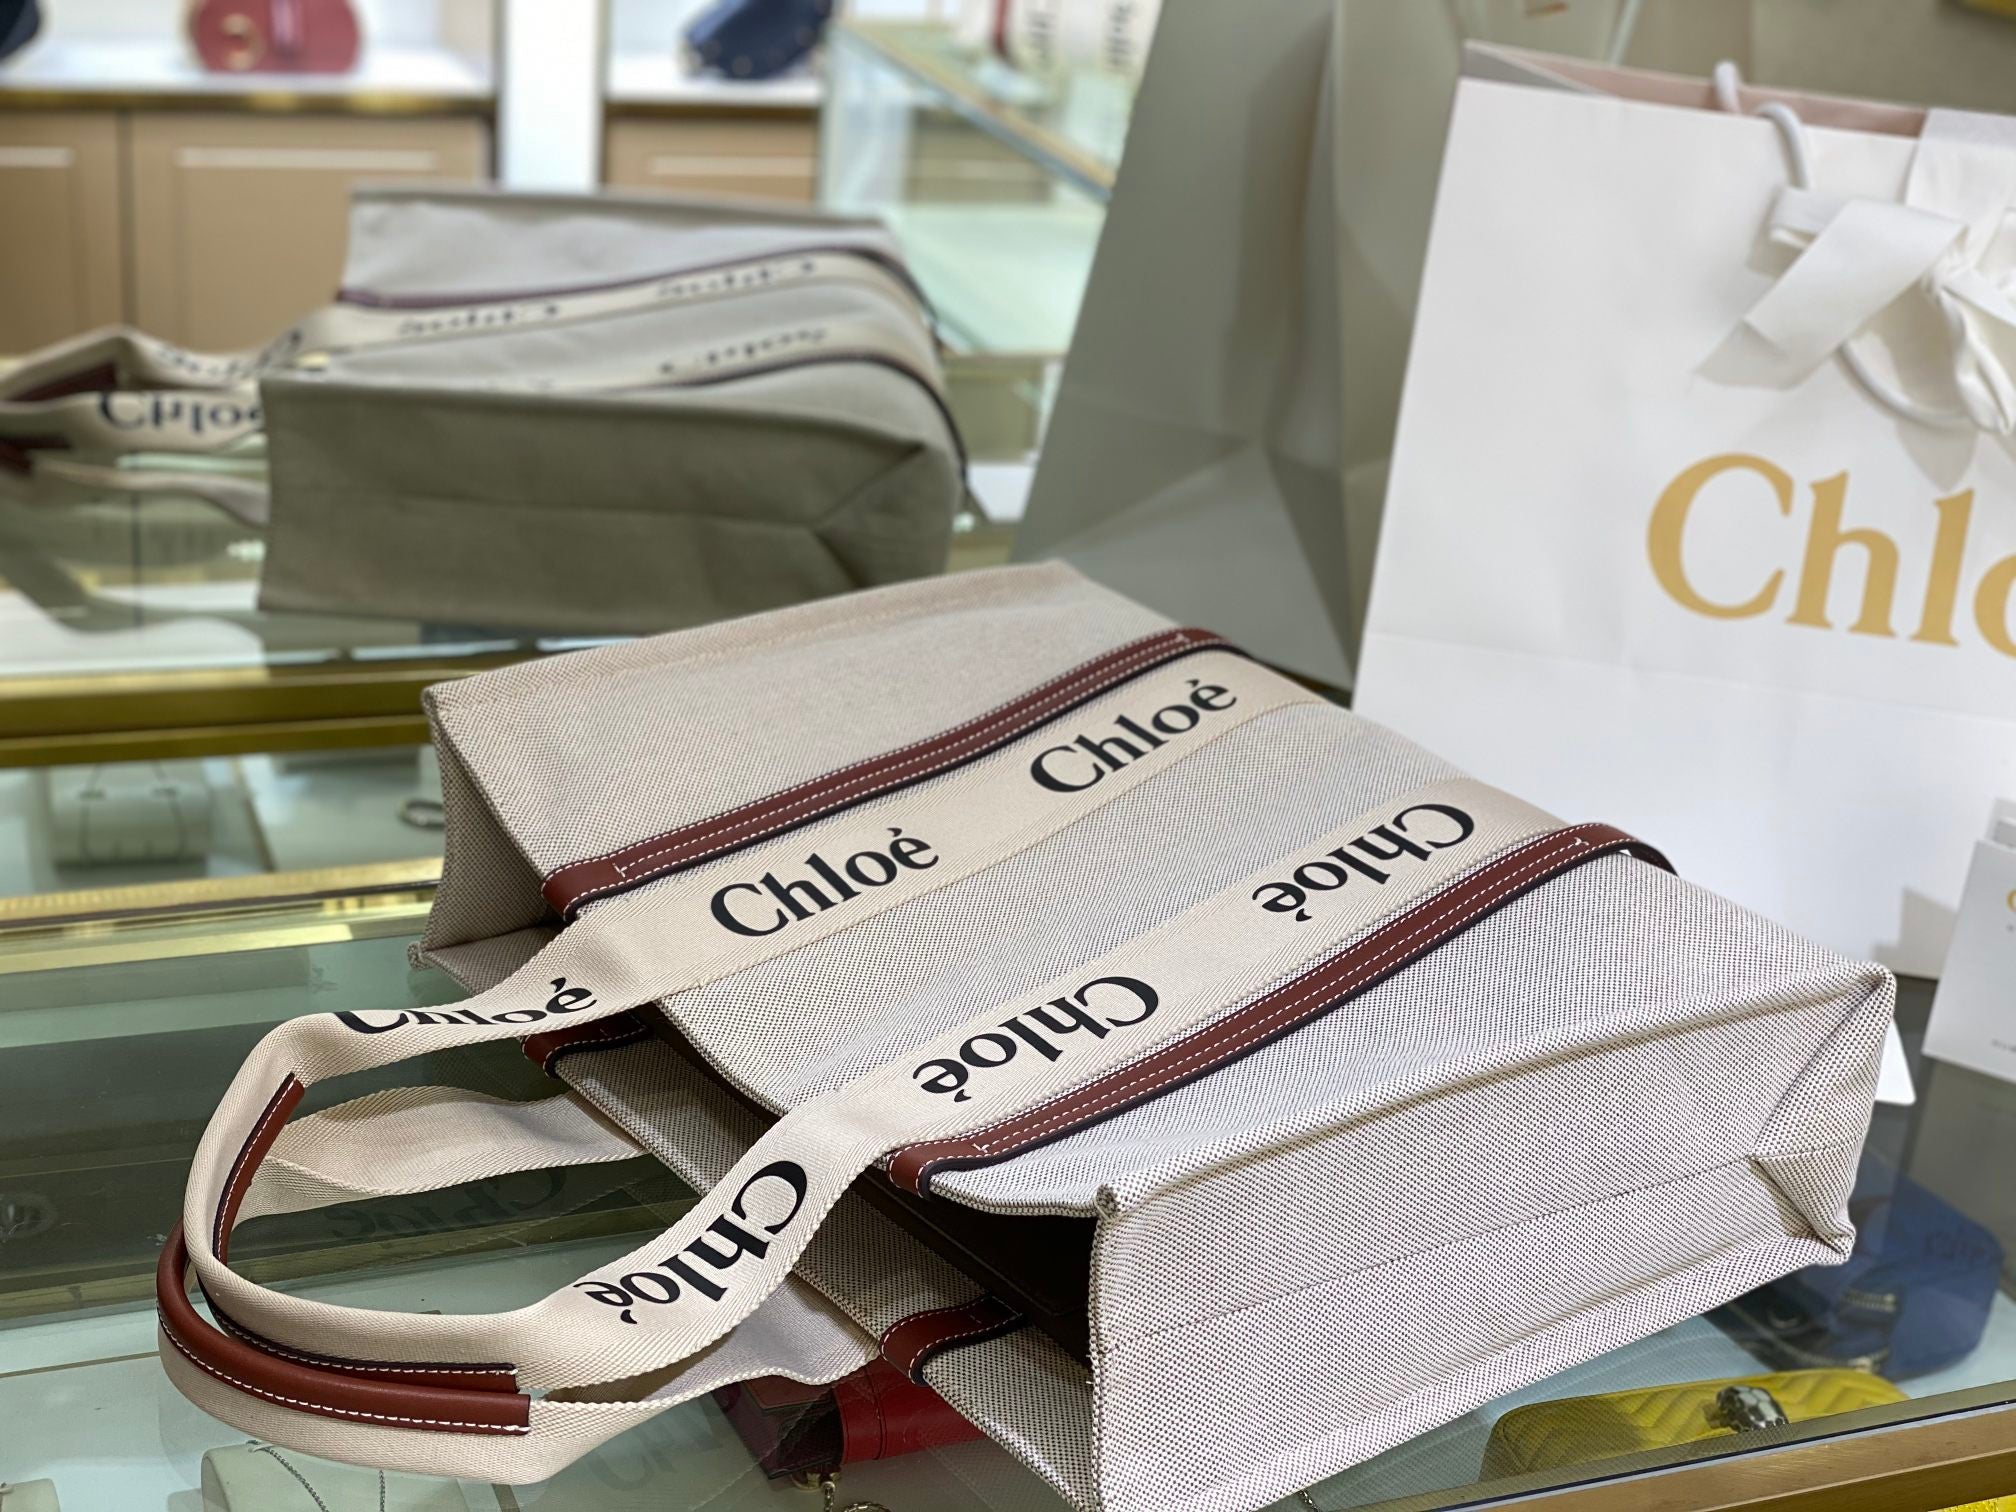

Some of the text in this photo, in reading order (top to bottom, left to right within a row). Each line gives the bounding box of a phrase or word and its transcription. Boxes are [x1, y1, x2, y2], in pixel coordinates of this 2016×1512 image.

[1030, 678, 1237, 793] Chloé
[710, 828, 940, 937] Chloé
[1252, 803, 1475, 922] Chloé
[912, 976, 1159, 1103] Chloé
[572, 1160, 808, 1325] Chloé
